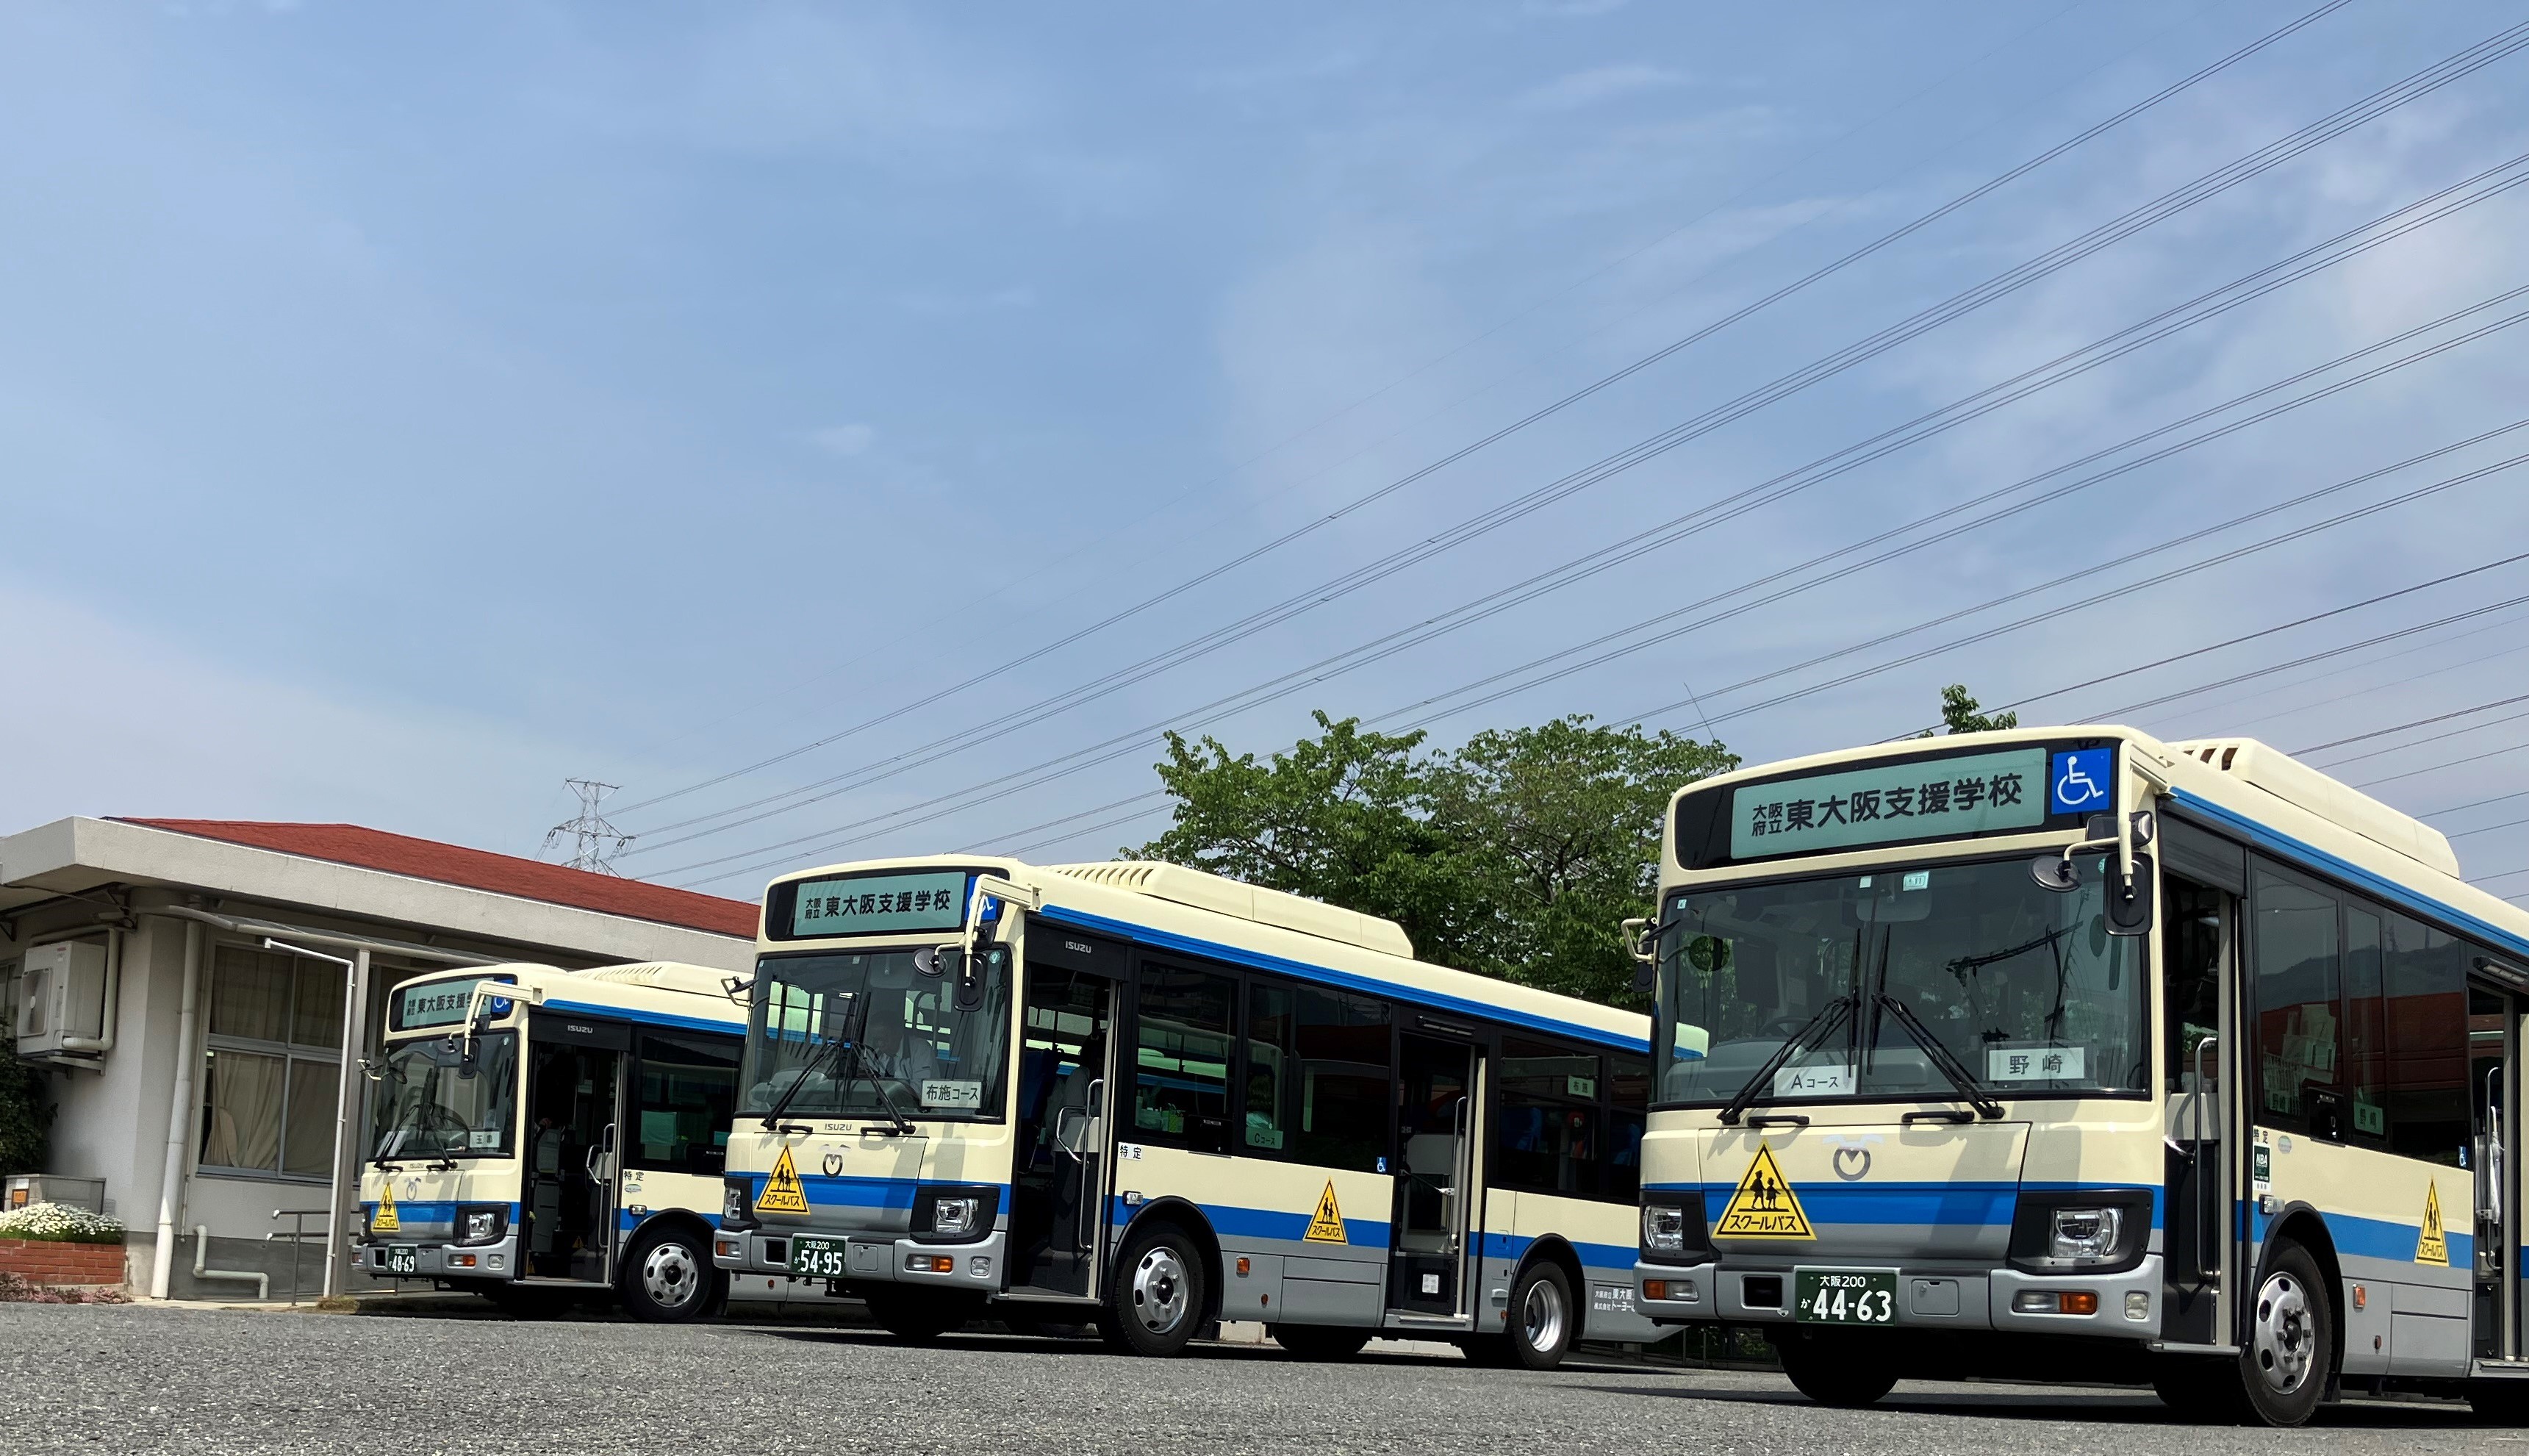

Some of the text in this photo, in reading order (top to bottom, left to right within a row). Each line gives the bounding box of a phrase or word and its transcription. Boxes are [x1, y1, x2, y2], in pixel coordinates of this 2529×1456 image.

[1784, 772, 2023, 831] 東大阪支援学校
[1752, 802, 1783, 820] 大阪
[1751, 818, 1782, 837] 府立
[824, 889, 951, 917] 東大阪支援学校
[1065, 940, 1092, 953] ISUZU
[417, 991, 487, 1014] 東大阪支援
[567, 1025, 593, 1034] ISUZU
[2009, 1053, 2063, 1075] 野崎
[1790, 1074, 1839, 1089] Aコース
[926, 1084, 979, 1101] 布施コース
[824, 1123, 853, 1131] ISUZU
[1119, 1144, 1142, 1160] 特定
[623, 1170, 645, 1182] 特定
[764, 1194, 800, 1207] スクールバス
[1729, 1214, 1797, 1231] スクールバス
[1312, 1225, 1341, 1238] スクールバス
[392, 1255, 415, 1272] 48-69
[800, 1249, 843, 1275] 54-95
[1812, 1288, 1892, 1321] 44-63
